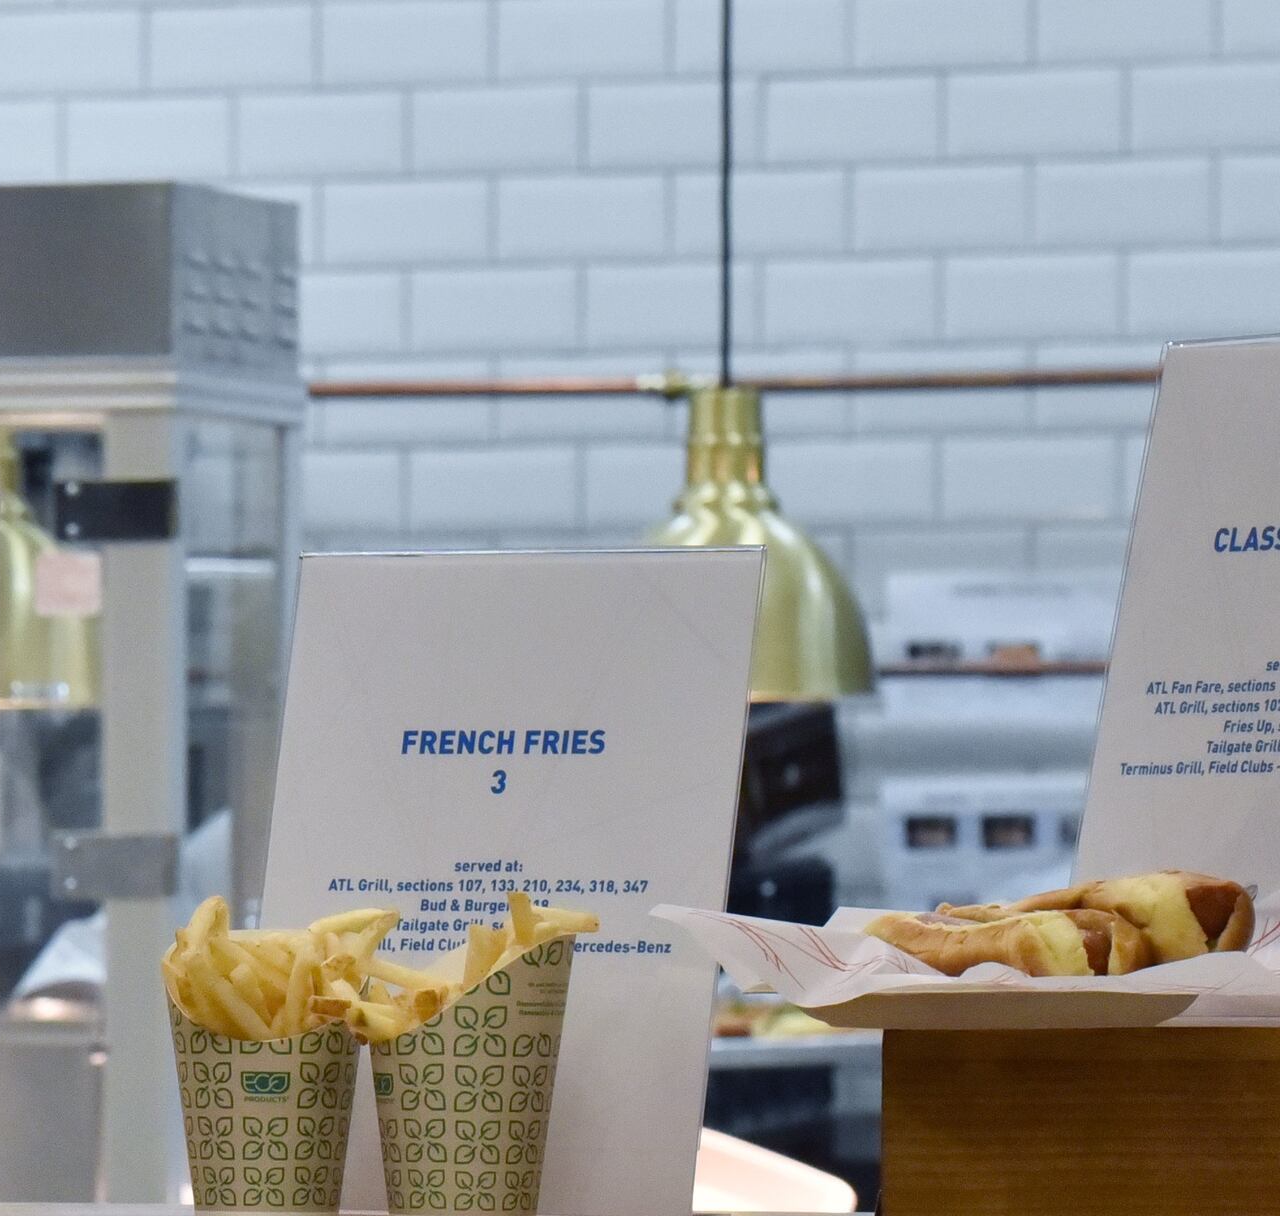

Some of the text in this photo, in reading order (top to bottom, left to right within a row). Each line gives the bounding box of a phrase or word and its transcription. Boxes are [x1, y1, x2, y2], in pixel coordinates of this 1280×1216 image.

[1214, 525, 1280, 553] CLAS
[1146, 679, 1277, 695] ATL Fan Fare, sections
[1154, 698, 1280, 716] ATL Grill, sections 10
[1223, 719, 1254, 734] Fries
[1256, 719, 1275, 735] Up,
[401, 729, 606, 755] FRENCH FRIES
[1207, 740, 1253, 757] Tailgate
[1120, 759, 1274, 777] Terminus Grill, Field Clubs
[490, 769, 507, 795] 3
[454, 859, 523, 873] served at:
[328, 878, 355, 892] ATL
[358, 878, 393, 894] Grill,
[396, 878, 454, 892] sections
[458, 878, 486, 894] 107,
[522, 879, 552, 894] 210,
[554, 879, 585, 894] 234,
[588, 879, 618, 894] 318,
[622, 879, 649, 894] 347
[420, 898, 447, 912] Bud
[450, 898, 461, 912] &
[377, 938, 672, 954] ill, Field Clu ercedes-Benz
